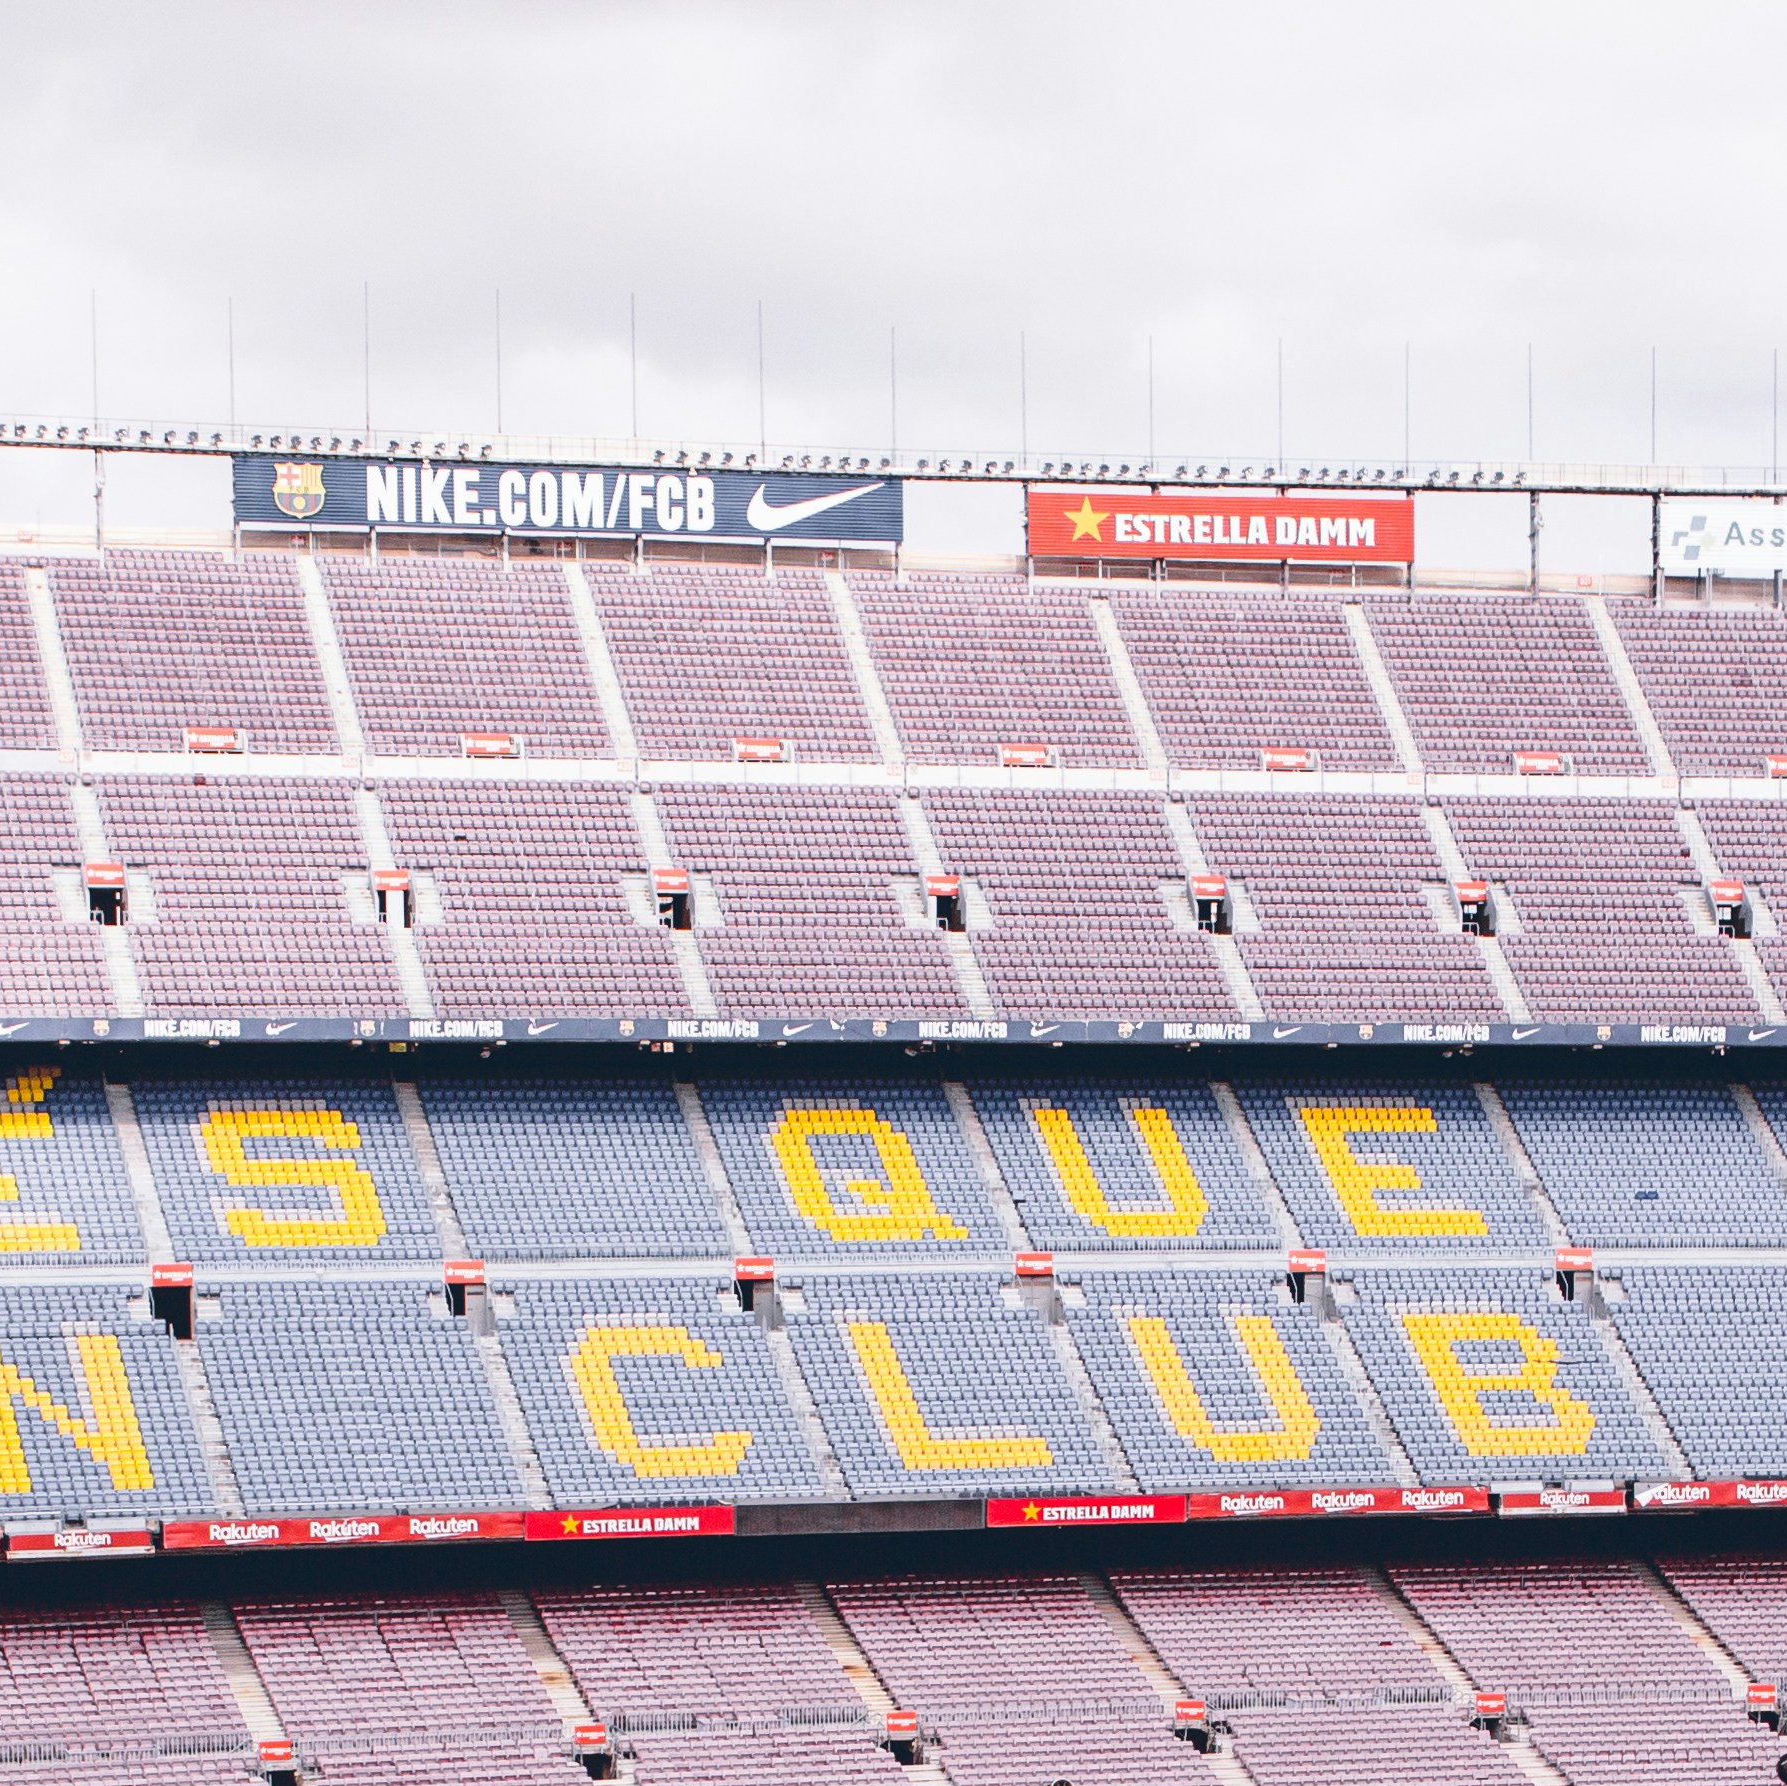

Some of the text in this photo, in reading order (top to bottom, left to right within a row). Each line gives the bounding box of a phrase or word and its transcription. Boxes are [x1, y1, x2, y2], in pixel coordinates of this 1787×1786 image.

[365, 465, 716, 532] NIKE.COM/FCB
[1115, 512, 1376, 547] ESTRELLA DAMM
[144, 1019, 241, 1038] NIKE.COM/FCB
[409, 1019, 503, 1038] NIKE.COM/FCB
[667, 1020, 759, 1039] NIKE.COM/FCB
[919, 1021, 1008, 1039] NIKE.COM/FCB
[1164, 1022, 1251, 1040] NIKE.COM/FCB
[1403, 1024, 1490, 1041] NIKE.COM/FCB
[1641, 1025, 1726, 1042] NIKE.COM/FCB
[768, 1106, 1489, 1242] QUE
[570, 1314, 1597, 1478] CLUB
[1220, 1494, 1284, 1511] Rakuten
[1311, 1491, 1375, 1507] Rakuten
[1401, 1489, 1464, 1506] Rakuten
[1043, 1504, 1155, 1521] ESTRELLA DAMM
[209, 1522, 280, 1541] Rakuten
[309, 1520, 380, 1539] Rakuten
[409, 1516, 479, 1535] Rakuten
[583, 1516, 700, 1535] ESTRELLA DAMM
[53, 1531, 111, 1547] Rakuten
